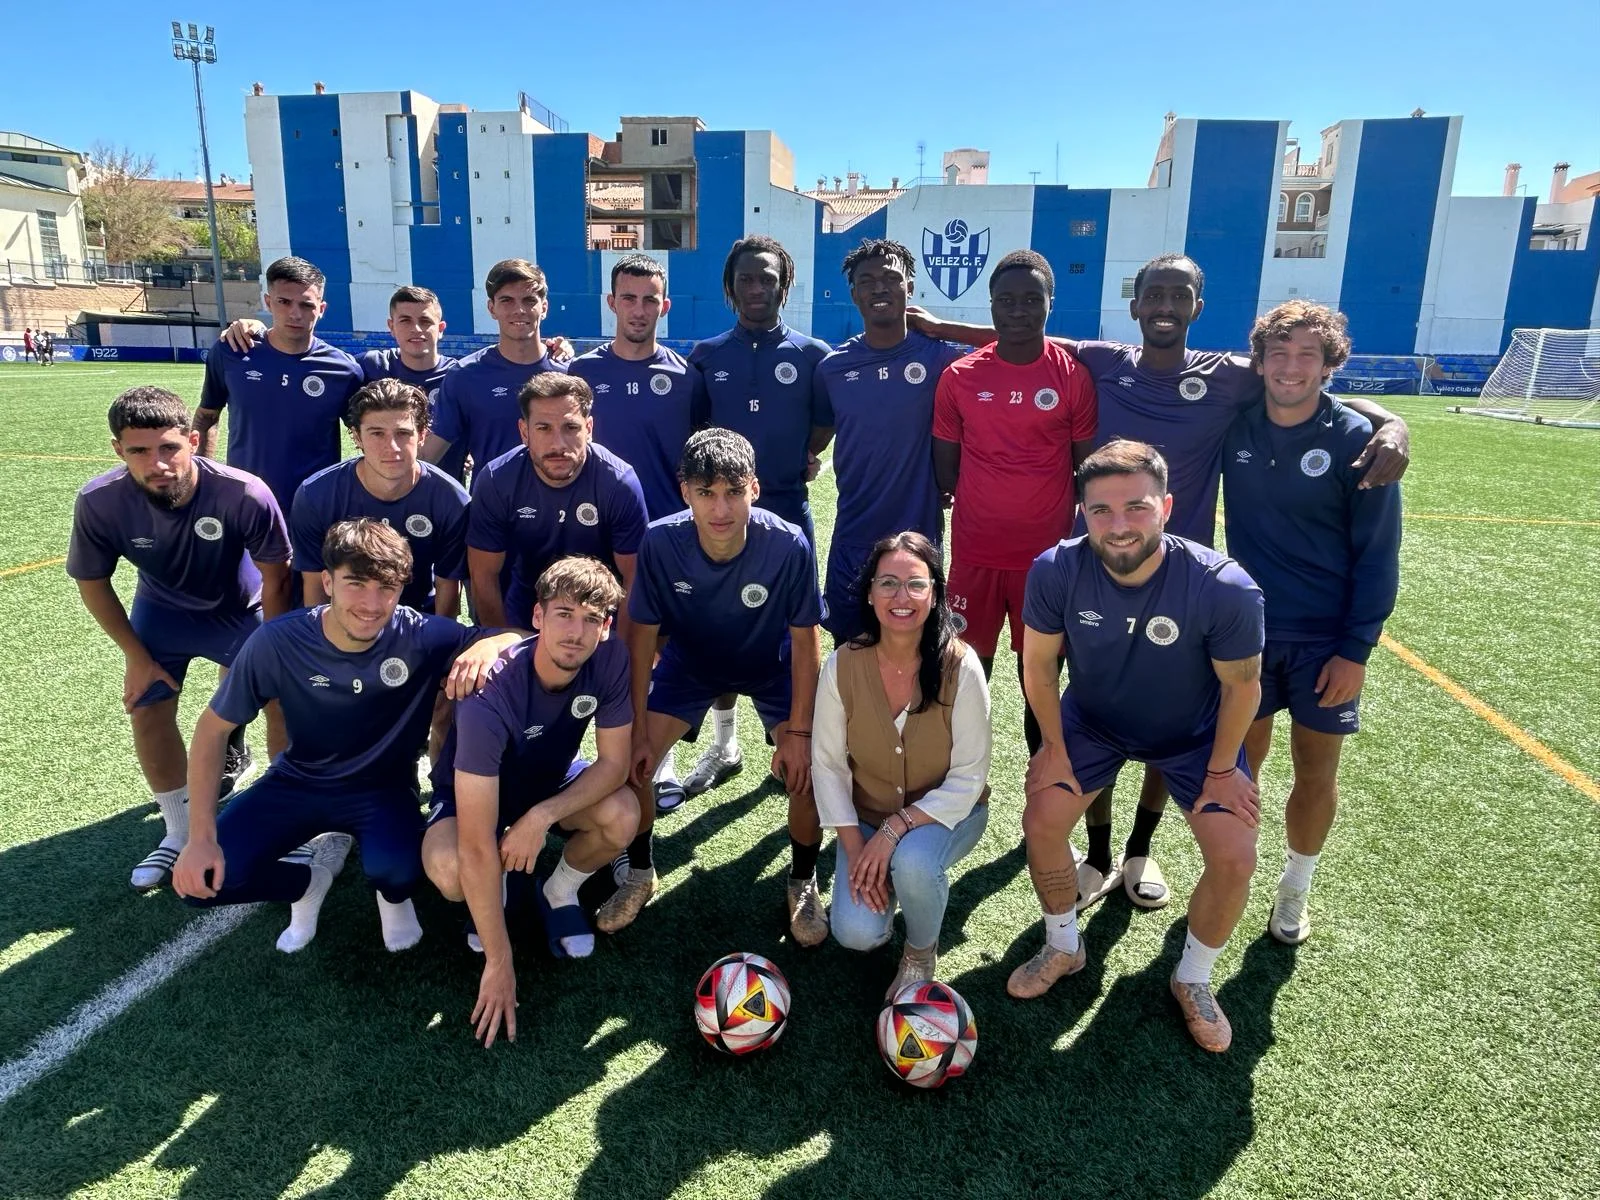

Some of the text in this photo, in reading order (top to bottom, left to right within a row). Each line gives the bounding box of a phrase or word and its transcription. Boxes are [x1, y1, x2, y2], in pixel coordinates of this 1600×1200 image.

[928, 256, 982, 266] VELEZ C. F.
[92, 348, 118, 358] 1922
[877, 367, 889, 380] 15
[281, 374, 289, 387] 5
[1347, 381, 1385, 391] 1922
[626, 382, 638, 394] 18
[1009, 391, 1022, 404] 23
[749, 399, 759, 411] 15
[558, 510, 565, 522] 2
[952, 594, 967, 611] 23
[1080, 619, 1099, 627] umbro
[1126, 617, 1137, 634] 7
[352, 678, 363, 694] 9
